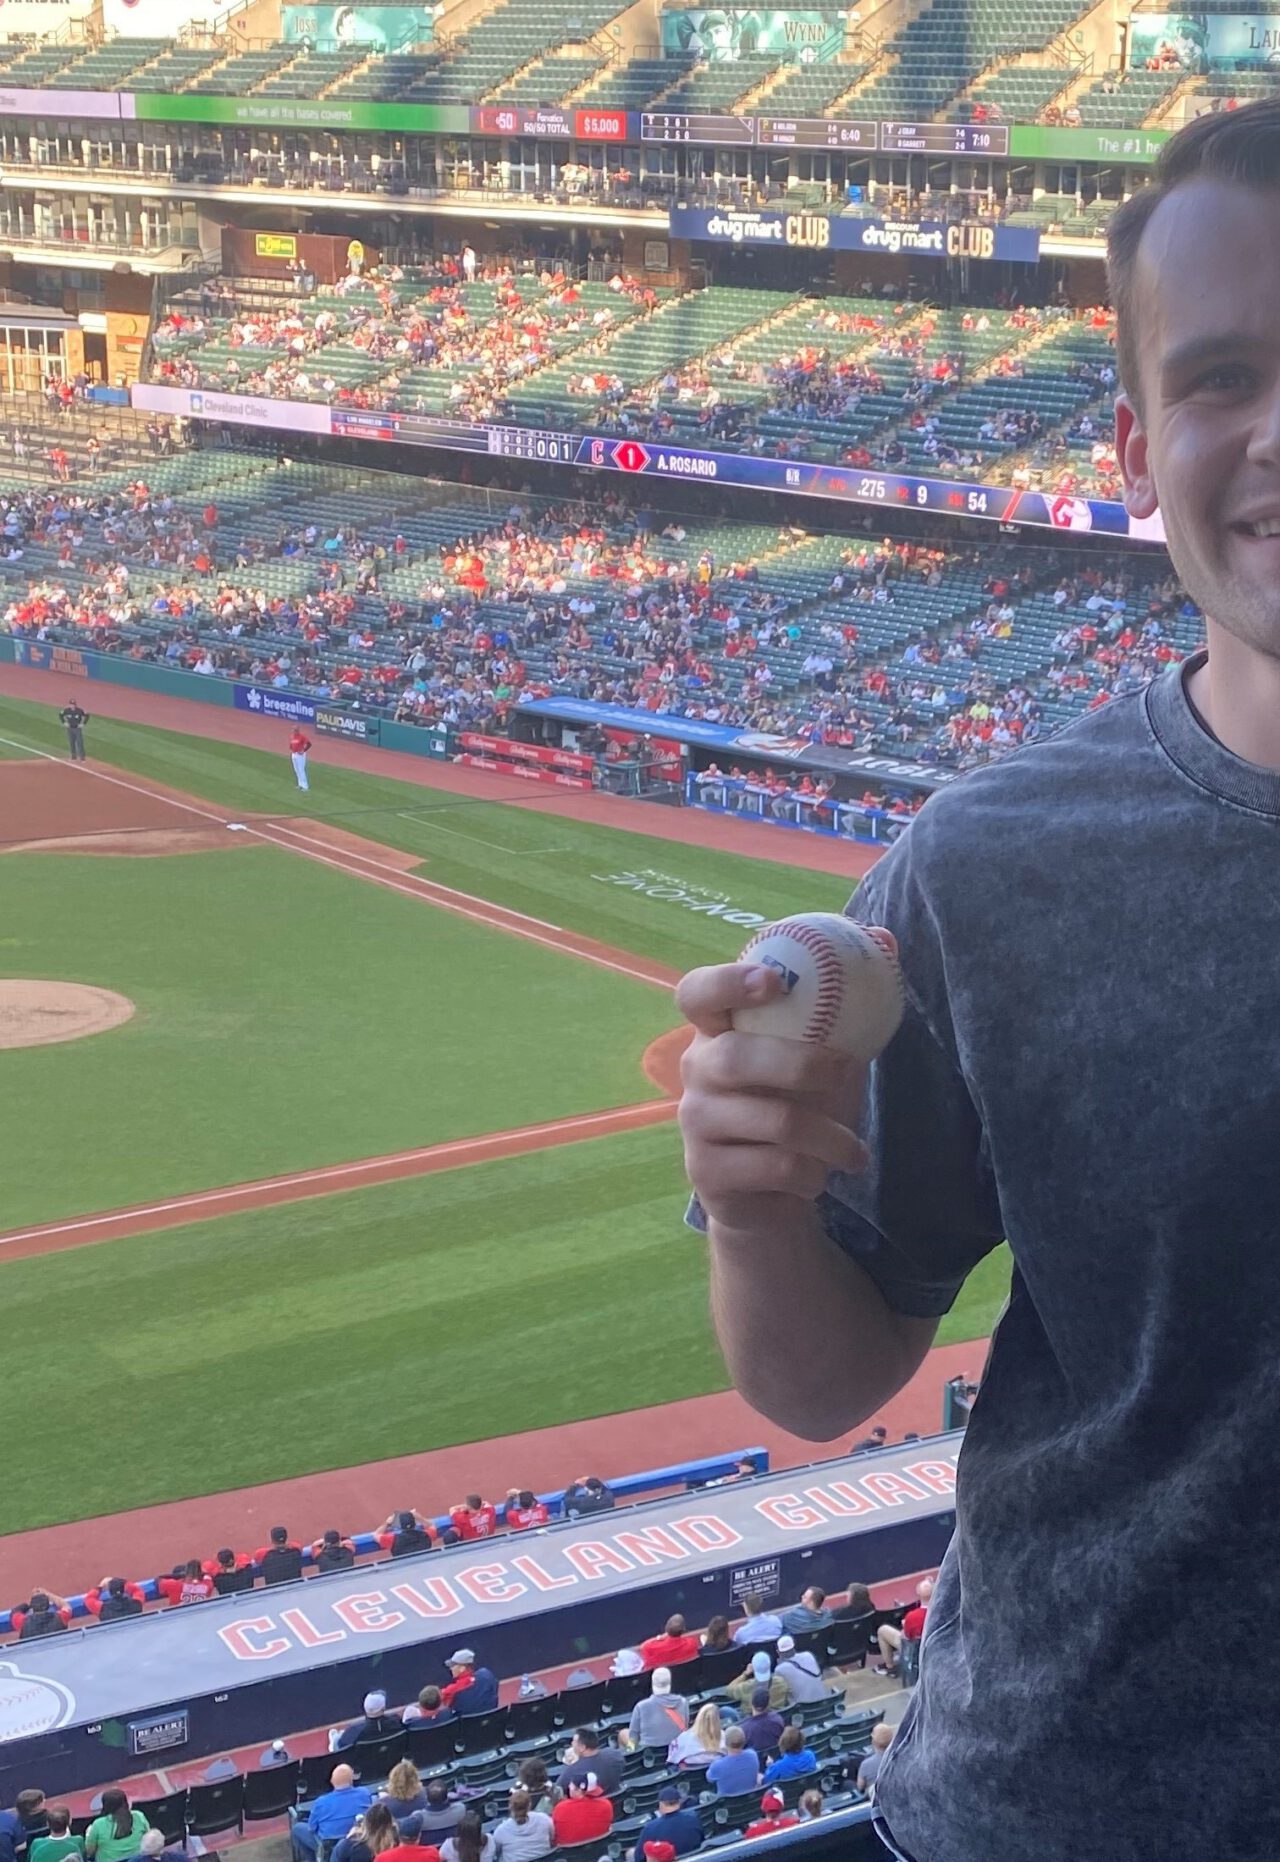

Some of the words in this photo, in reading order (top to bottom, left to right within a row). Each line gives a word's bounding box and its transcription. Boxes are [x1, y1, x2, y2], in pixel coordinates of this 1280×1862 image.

[783, 20, 828, 42] WYNN
[548, 123, 570, 134] TOTAL
[840, 128, 860, 141] 6:40
[972, 133, 990, 147] 7:10
[1097, 137, 1118, 152] The
[1123, 138, 1141, 153] #1
[707, 215, 743, 242] drug
[744, 220, 782, 238] mart
[785, 215, 829, 247] CLUB
[862, 225, 900, 252] drug
[902, 230, 942, 249] mart
[946, 226, 994, 257] CLUB
[204, 400, 244, 415] Cleveland
[245, 406, 268, 418] Clinic
[537, 440, 545, 457] 0
[549, 441, 557, 458] 0
[627, 447, 634, 467] 1
[657, 454, 668, 470] A.
[669, 455, 717, 477] ROSARIO
[857, 478, 885, 498] .275
[917, 485, 928, 504] 9
[968, 492, 987, 512] 54
[263, 694, 314, 717] breezeline
[734, 1570, 746, 1580] BE
[748, 1562, 777, 1577] ALERT
[216, 1514, 742, 1662] CLEVELAND
[138, 1729, 148, 1737] BE
[152, 1720, 184, 1733] ALERT
